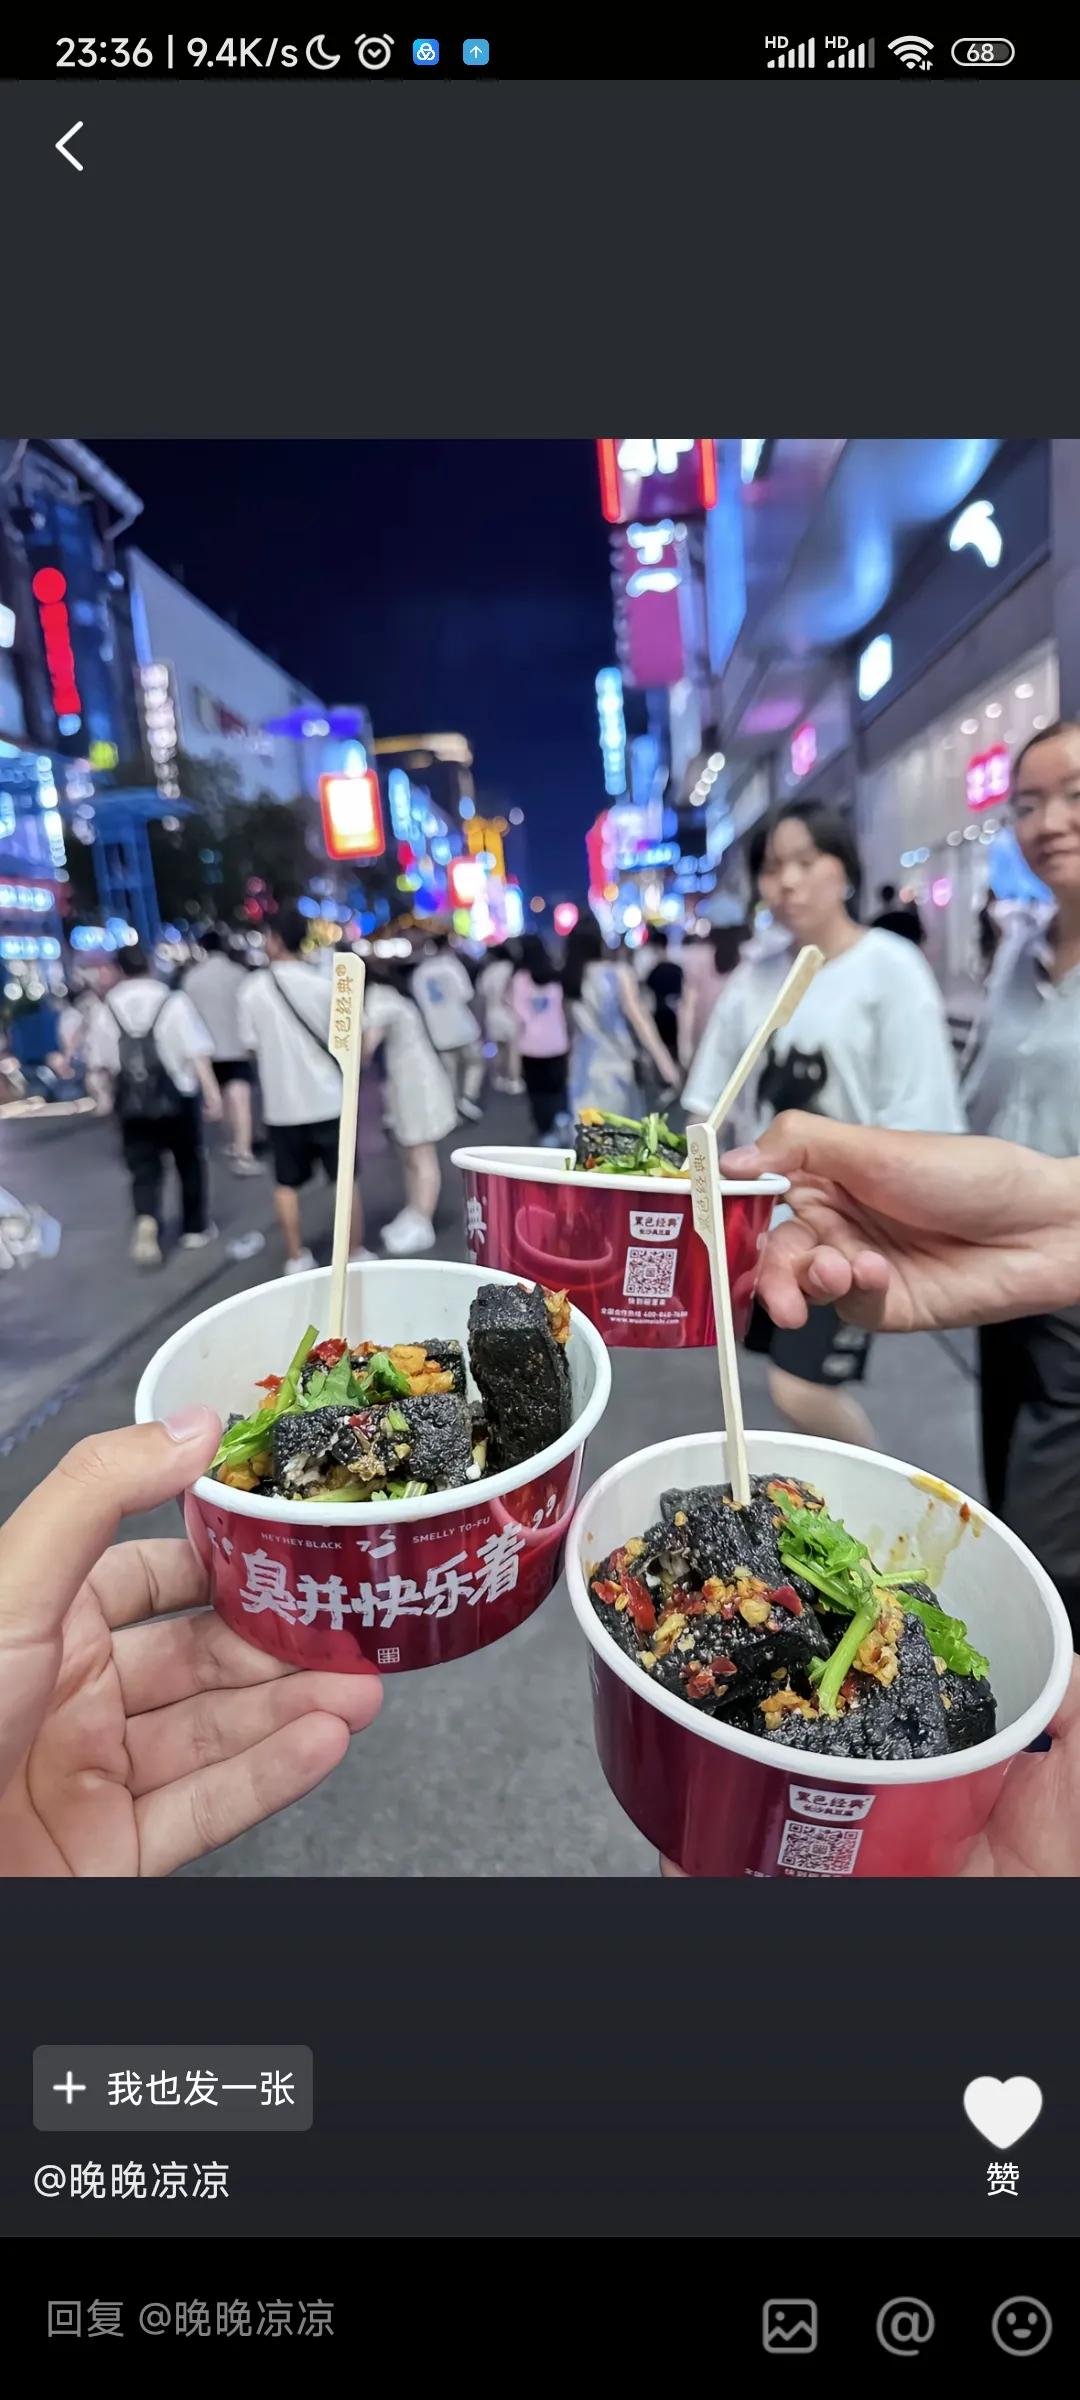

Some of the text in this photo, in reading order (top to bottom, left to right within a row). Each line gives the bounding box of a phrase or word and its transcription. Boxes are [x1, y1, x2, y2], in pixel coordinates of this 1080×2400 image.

[261, 1532, 343, 1550] HEY HEY BLACK
[412, 1516, 491, 1544] SMELLY TO-FU
